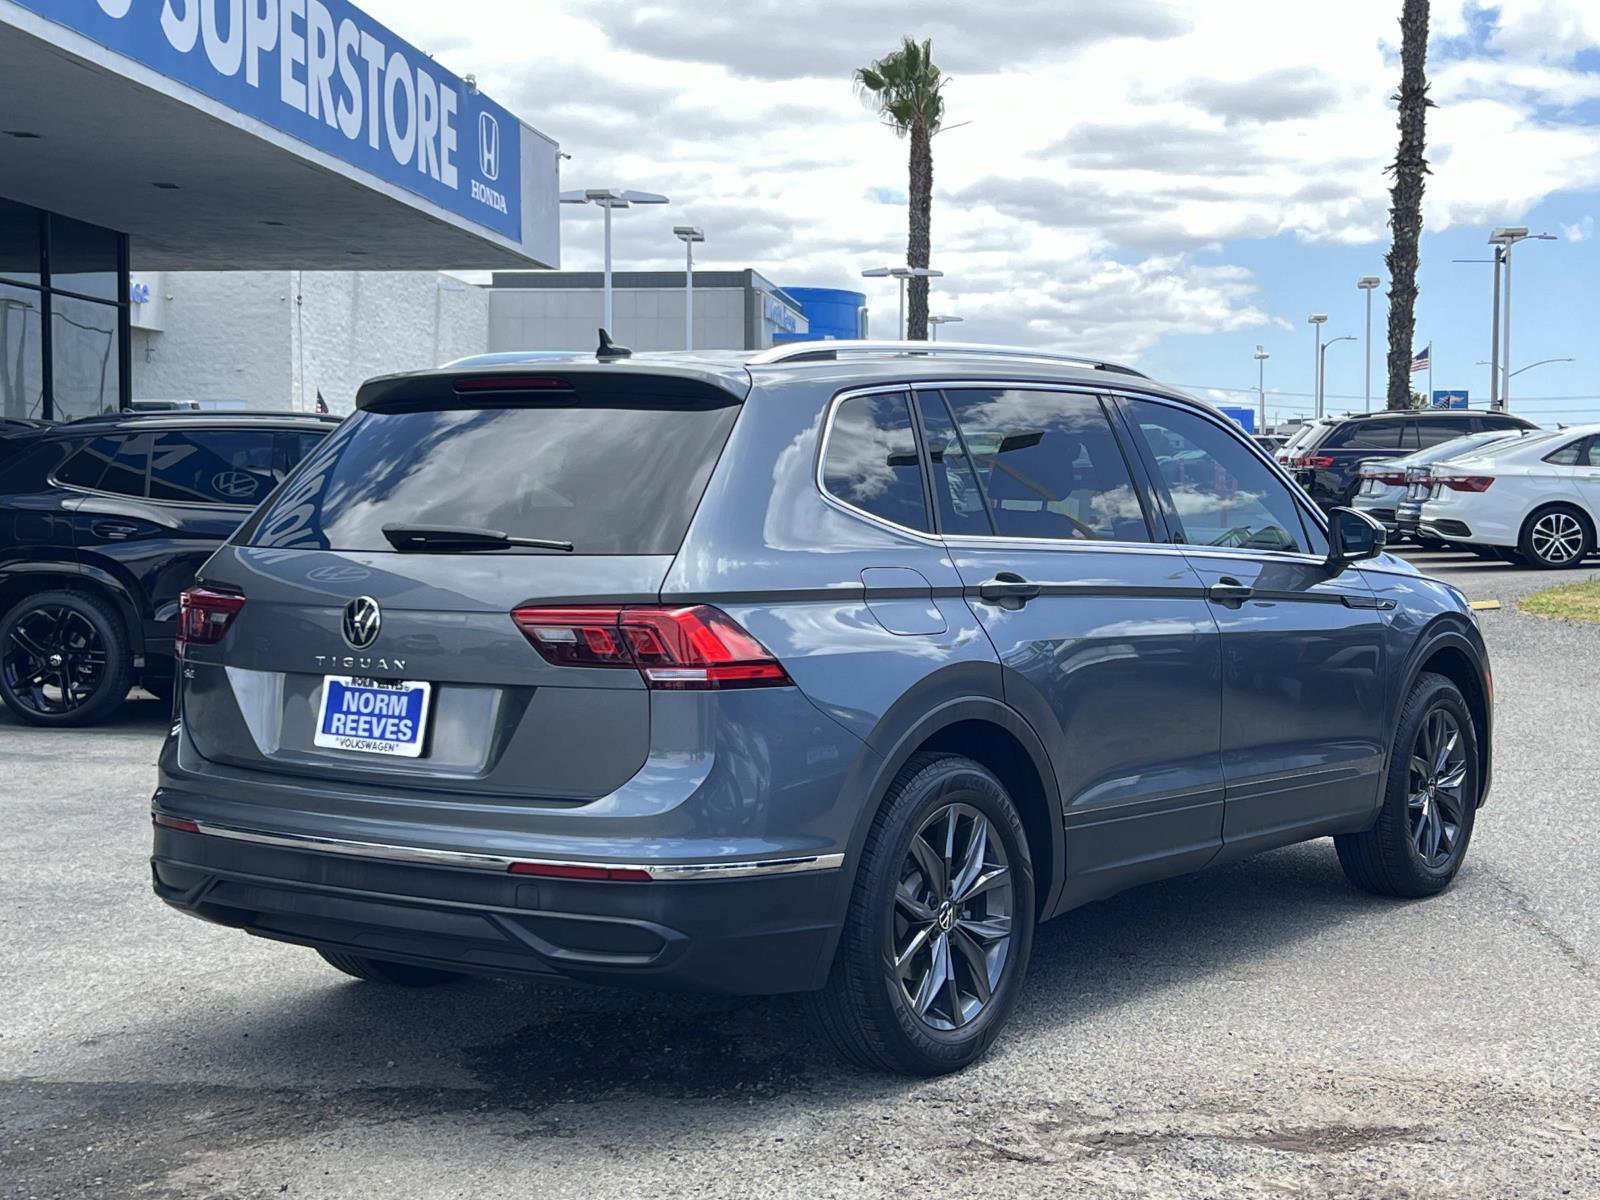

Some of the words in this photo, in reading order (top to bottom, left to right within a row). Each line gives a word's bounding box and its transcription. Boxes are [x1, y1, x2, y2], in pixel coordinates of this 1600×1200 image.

[471, 179, 508, 214] HONDA
[315, 655, 406, 670] TIGUAN
[342, 691, 409, 717] NORM
[331, 713, 413, 741] REEVES
